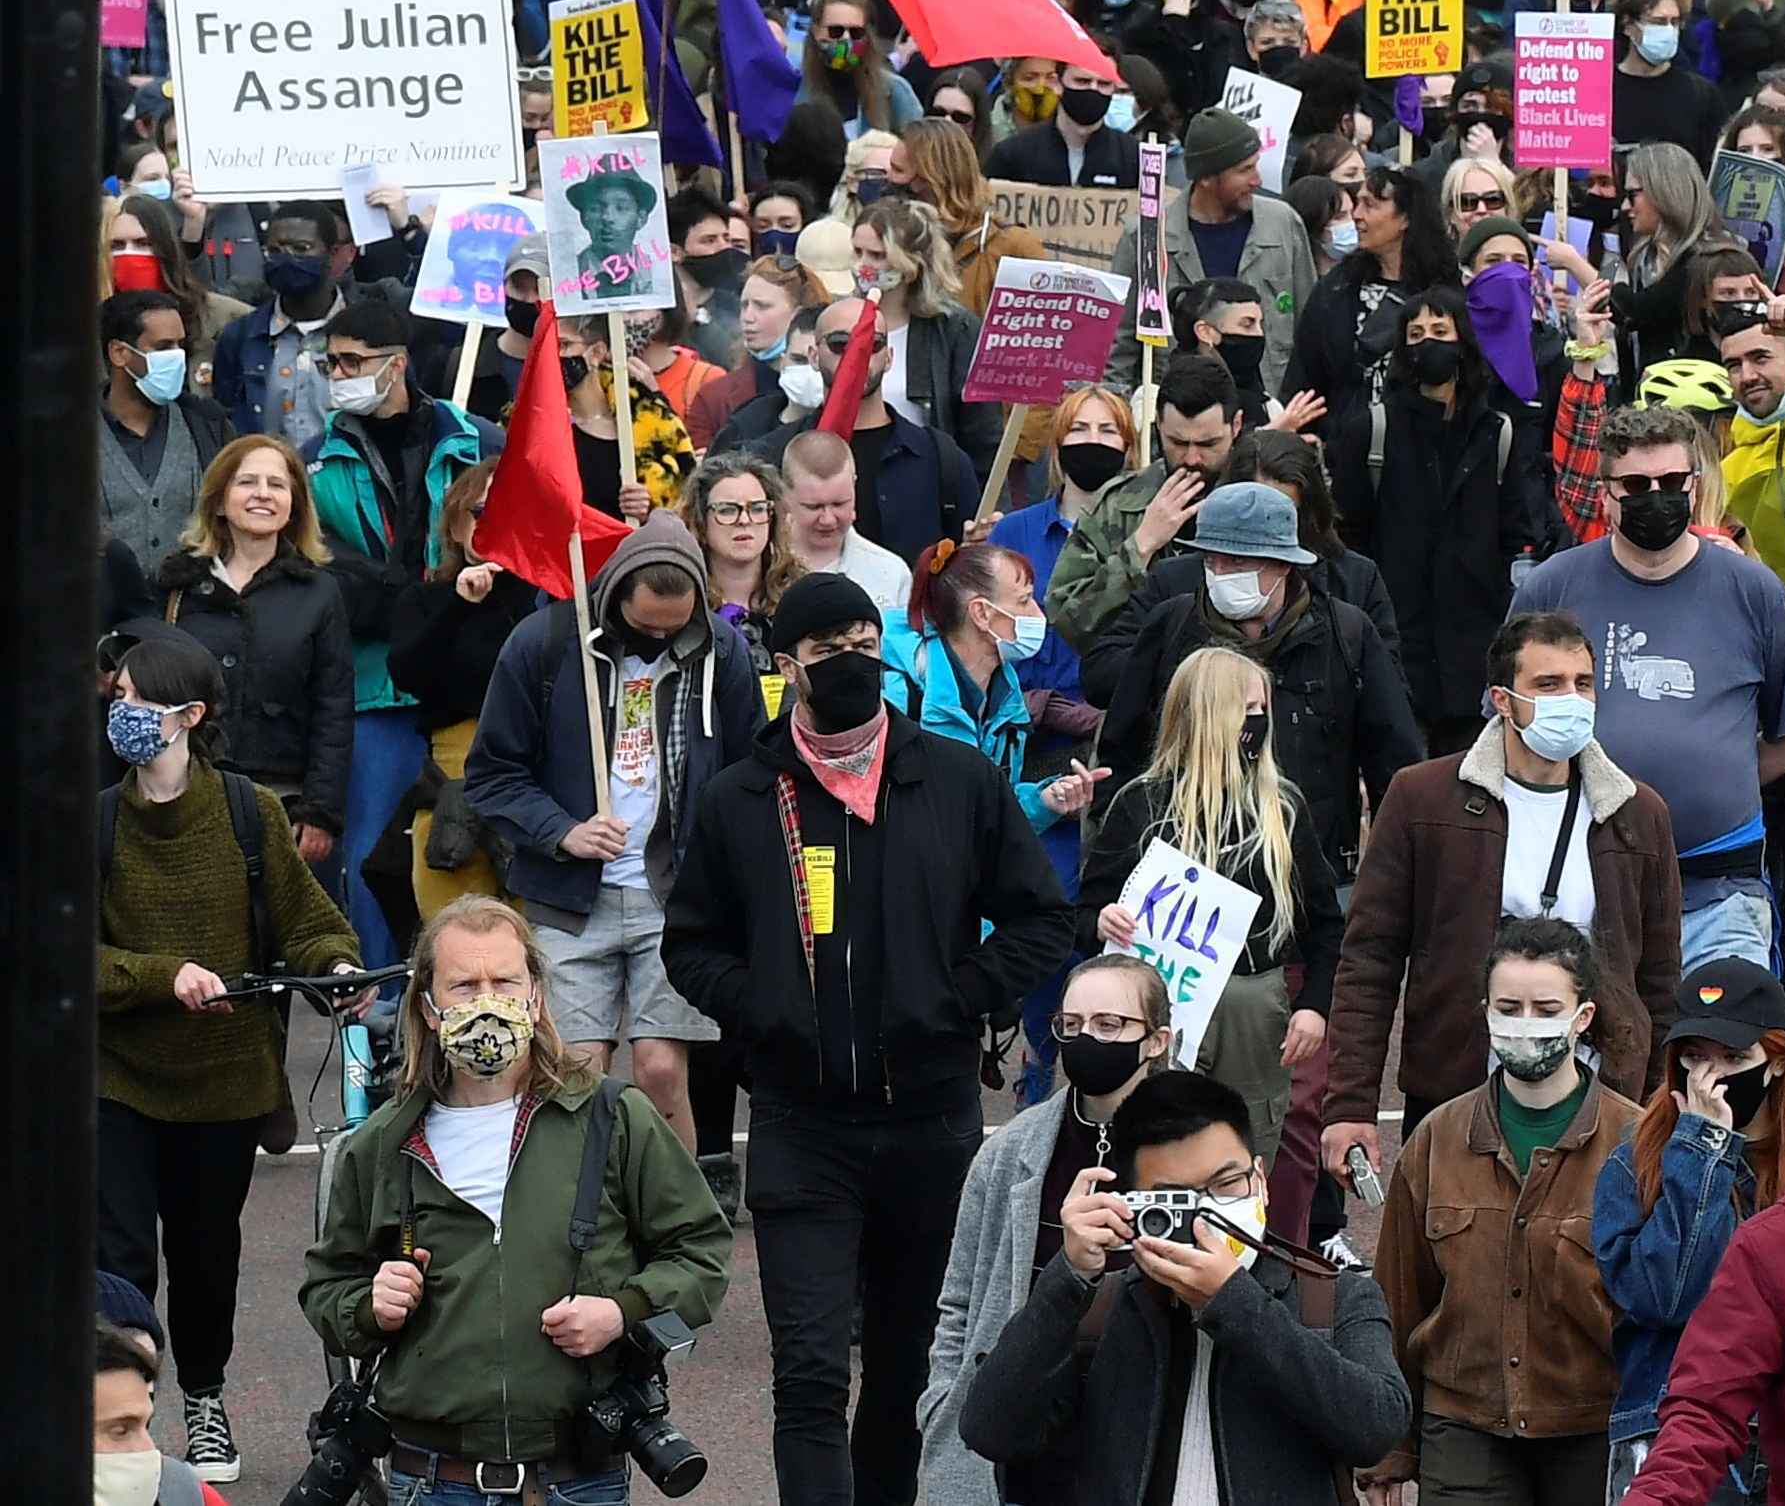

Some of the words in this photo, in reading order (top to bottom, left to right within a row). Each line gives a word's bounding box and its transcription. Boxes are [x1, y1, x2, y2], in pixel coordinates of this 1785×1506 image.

[194, 12, 313, 55] Free
[337, 2, 488, 52] Julian
[564, 12, 632, 51] KILL
[1379, 4, 1450, 37] BILL
[1379, 38, 1396, 50] NO
[1399, 35, 1433, 48] MORE
[1379, 49, 1420, 62] POLICE
[1518, 39, 1575, 61] Defend
[1576, 42, 1605, 61] the
[562, 41, 622, 77] THE
[1378, 58, 1428, 73] POWERS
[1518, 63, 1558, 85] right
[1561, 65, 1580, 82] to
[233, 70, 464, 119] Assange
[566, 68, 634, 108] BILL
[1517, 86, 1577, 107] protest
[1518, 108, 1560, 125] Black
[1563, 110, 1606, 127] Lives
[204, 145, 264, 173] Nobel
[273, 142, 336, 170] Peace
[343, 139, 398, 169] Prize
[406, 134, 502, 165] Nominee
[1518, 131, 1572, 150] Matter
[601, 238, 671, 285] BILL
[997, 290, 1075, 316] Defend
[1074, 297, 1111, 319] the
[990, 311, 1057, 334] right
[1058, 317, 1074, 332] to
[985, 332, 1065, 354] protest
[1135, 873, 1221, 964] KILL
